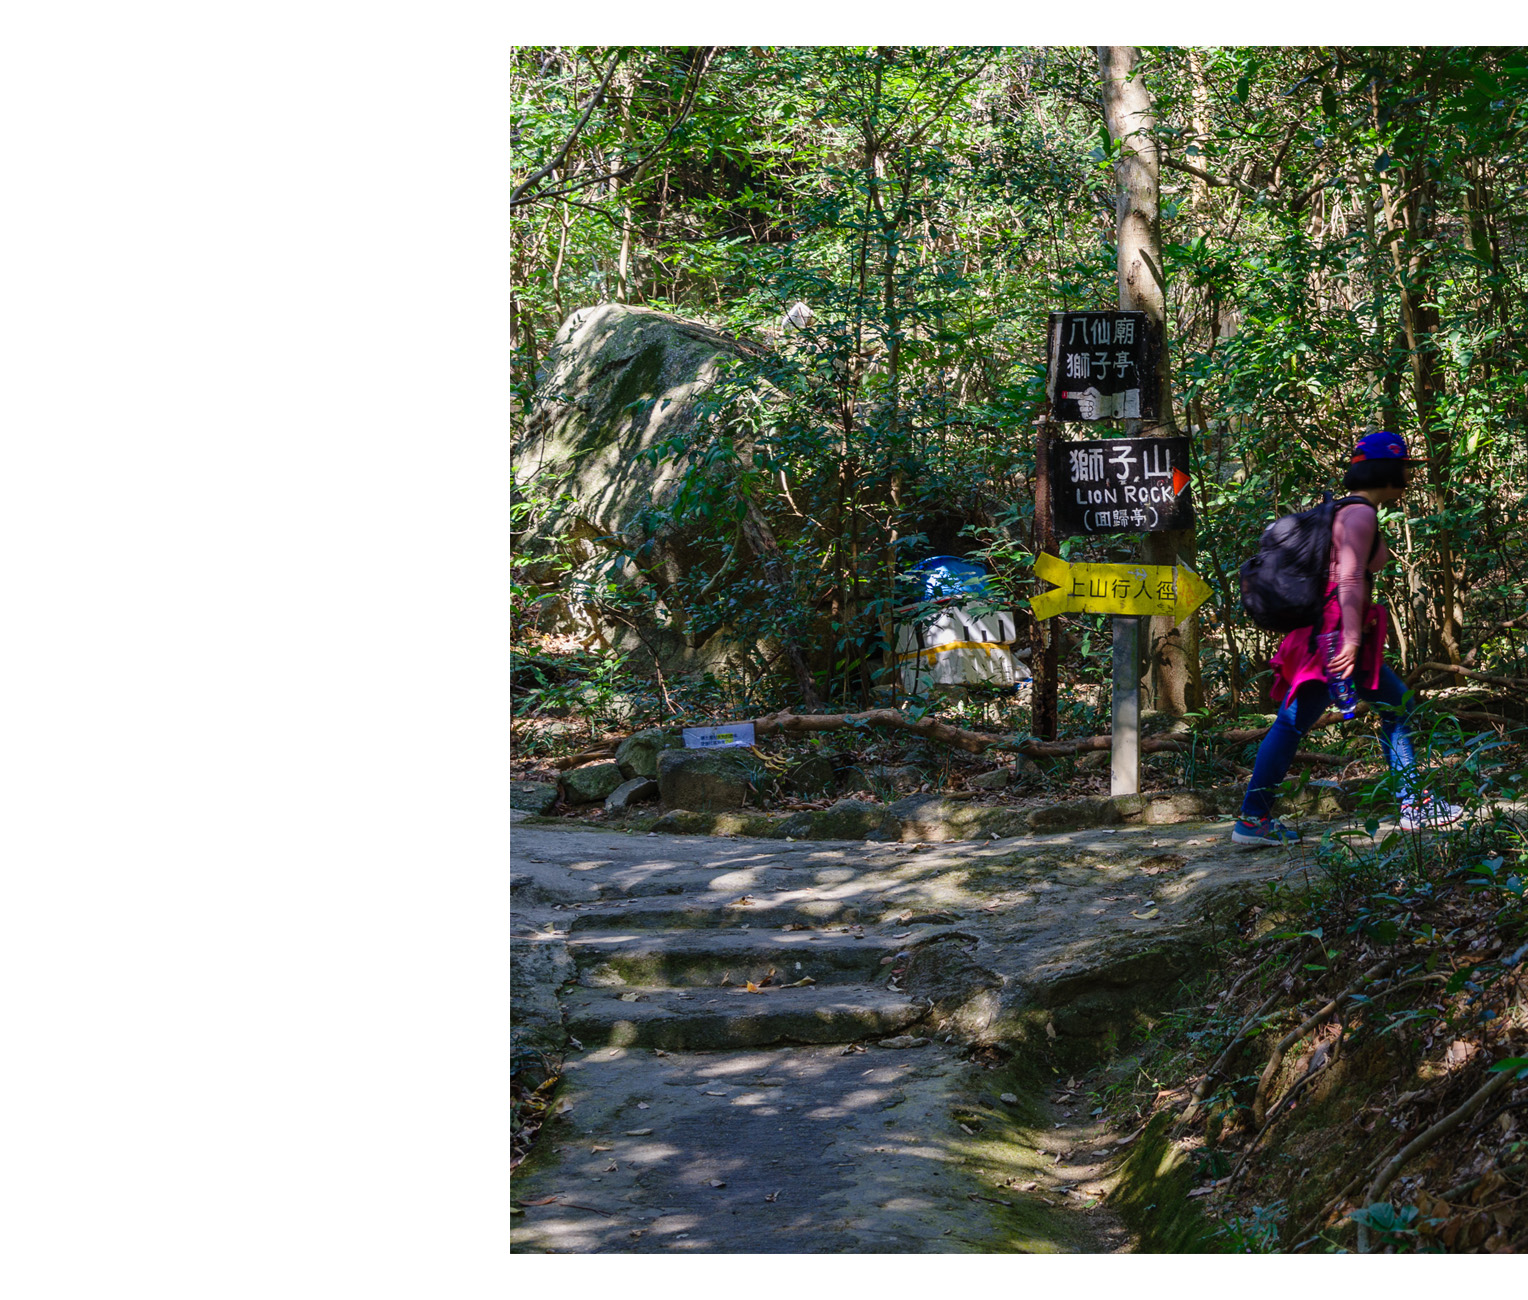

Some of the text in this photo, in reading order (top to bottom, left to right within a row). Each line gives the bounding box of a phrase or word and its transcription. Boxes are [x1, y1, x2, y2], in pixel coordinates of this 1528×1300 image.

[1068, 317, 1135, 345] 八仙廟
[1066, 351, 1134, 380] 獅子亭
[1069, 444, 1172, 482] 獅子山
[1076, 485, 1174, 505] LION ROCK
[1068, 578, 1175, 600] 上山行人徑
